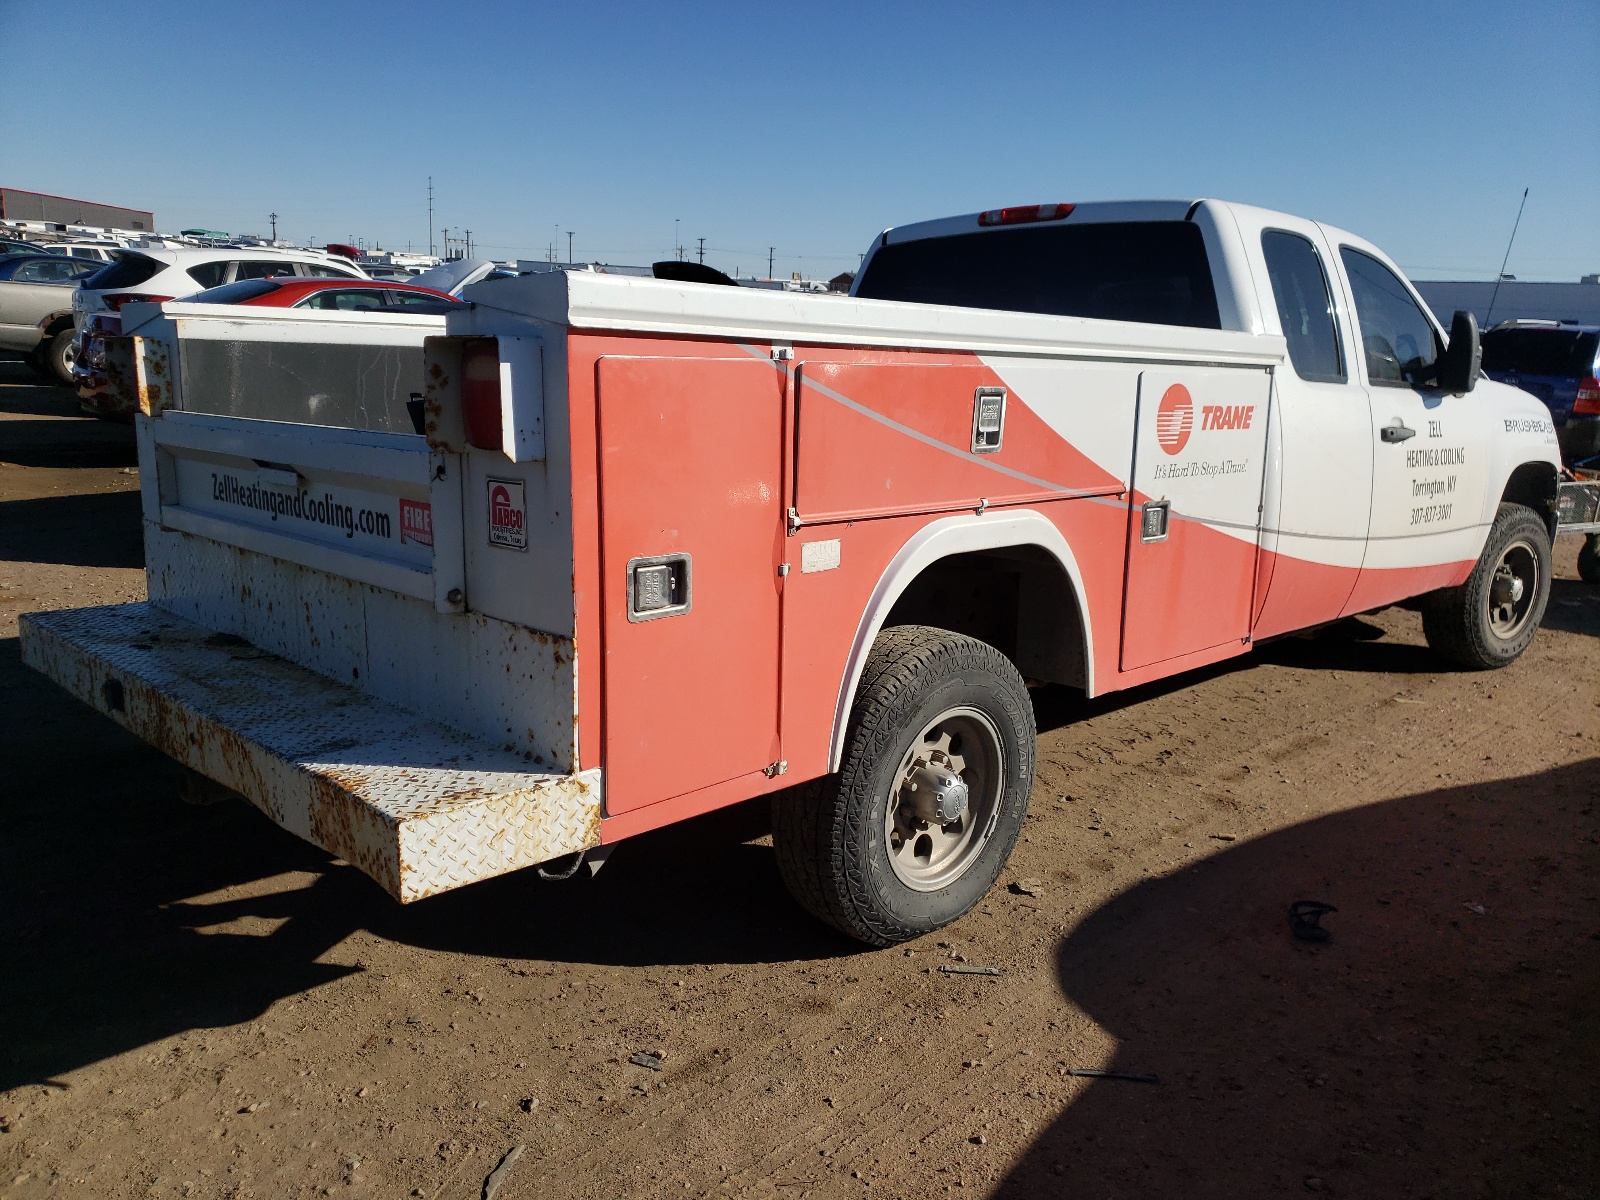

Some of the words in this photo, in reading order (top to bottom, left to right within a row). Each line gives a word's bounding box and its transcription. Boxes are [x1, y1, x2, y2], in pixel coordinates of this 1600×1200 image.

[1201, 405, 1254, 430] TRANE
[1428, 420, 1443, 438] ZELL
[1154, 464, 1167, 480] It's
[1167, 462, 1190, 479] Hard
[1190, 461, 1200, 477] To
[1200, 460, 1219, 479] Stop
[1218, 459, 1226, 475] A
[1406, 449, 1433, 469] HEATING
[1434, 448, 1440, 466] &
[1440, 446, 1465, 466] COOLING
[1412, 477, 1446, 500] Torrington,
[1447, 475, 1457, 493] WY
[211, 473, 391, 538] ZellHeatingandCooling.com
[403, 505, 431, 532] FIRE
[991, 688, 1027, 780] ROADIAN
[867, 794, 902, 915] NEXEN
